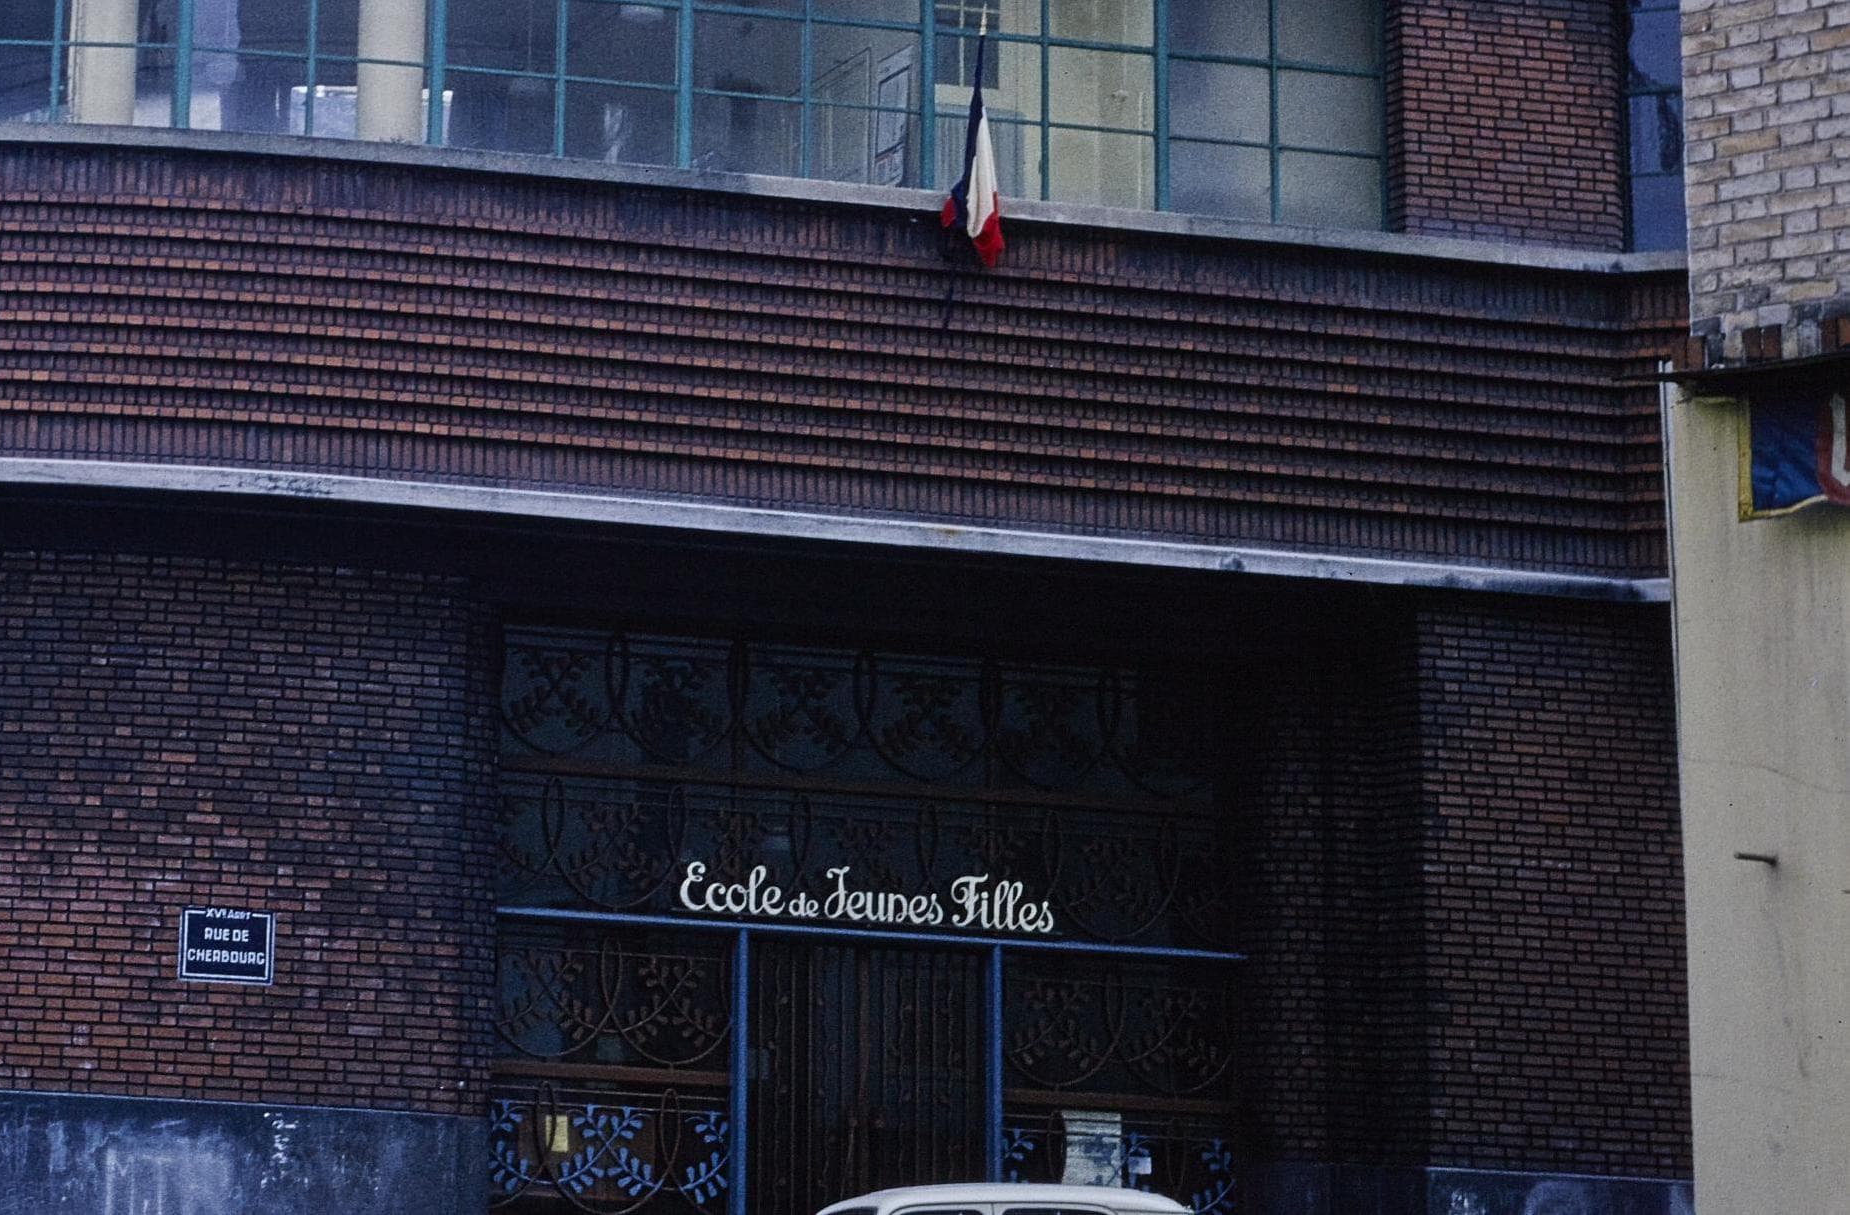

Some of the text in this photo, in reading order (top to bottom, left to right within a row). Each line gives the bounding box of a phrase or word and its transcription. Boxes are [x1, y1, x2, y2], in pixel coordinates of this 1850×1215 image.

[679, 861, 1054, 933] Ecole de Jeunes Filles
[204, 927, 249, 942] RUE DE
[187, 948, 265, 965] CHERBOURG
